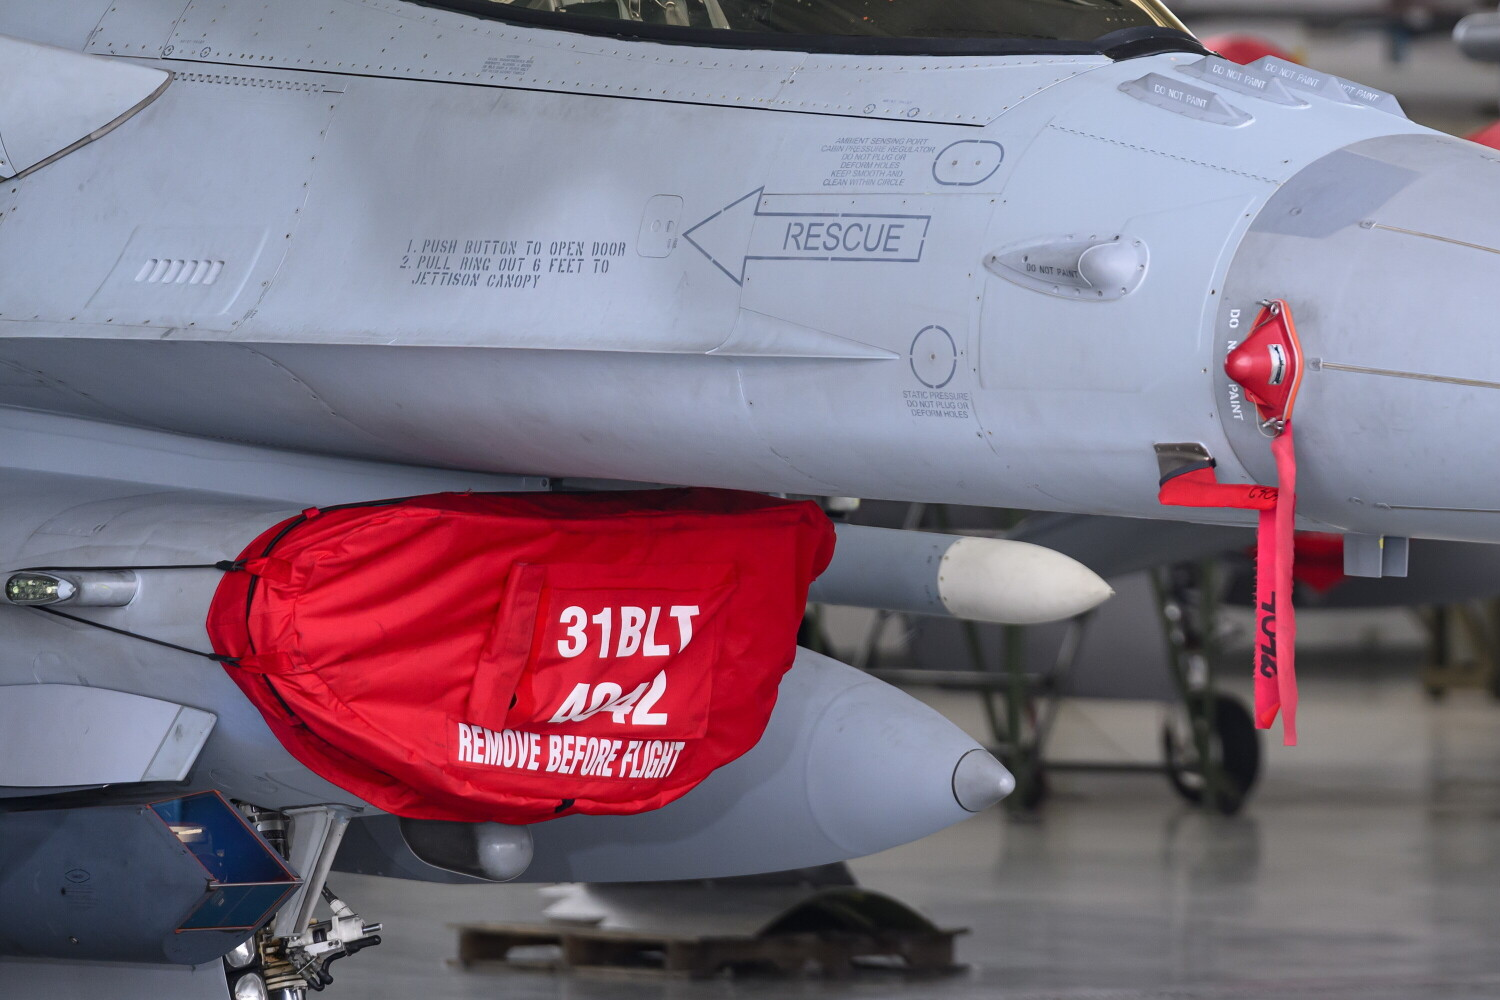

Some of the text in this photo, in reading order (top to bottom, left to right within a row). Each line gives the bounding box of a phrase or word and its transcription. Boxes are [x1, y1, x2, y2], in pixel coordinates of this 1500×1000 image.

[1212, 64, 1267, 89] DO NOT PAINT
[1265, 63, 1320, 88] DO NOT PAINT
[1154, 84, 1208, 109] DO NOT PAINT
[1356, 89, 1379, 102] PAINT
[845, 145, 887, 153] PRESSURE
[840, 161, 901, 169] DEFORM HOLES
[782, 222, 905, 252] RESCUE
[421, 239, 458, 254] PUSH
[464, 240, 518, 255] BUTTON
[526, 240, 542, 255] TO
[549, 241, 585, 256] OPEN
[591, 241, 627, 257] DOOR
[416, 255, 451, 270] PULL
[459, 256, 491, 271] RING
[498, 257, 526, 272] OUT
[532, 258, 542, 272] 6
[548, 258, 585, 273] FEET
[593, 258, 610, 274] TO
[1026, 263, 1079, 278] DO NOT PAINT
[411, 271, 541, 288] JETTISON CANOPY
[1228, 308, 1241, 329] DO
[902, 390, 969, 401] STATIC PRESSURE
[1228, 384, 1244, 421] PAINT
[906, 399, 970, 411] DO NOT PLUG OR
[911, 409, 969, 419] DEFORM HOLES
[557, 605, 700, 659] 31BLT
[458, 722, 686, 779] REMOVE BEFORE FLIGHT
